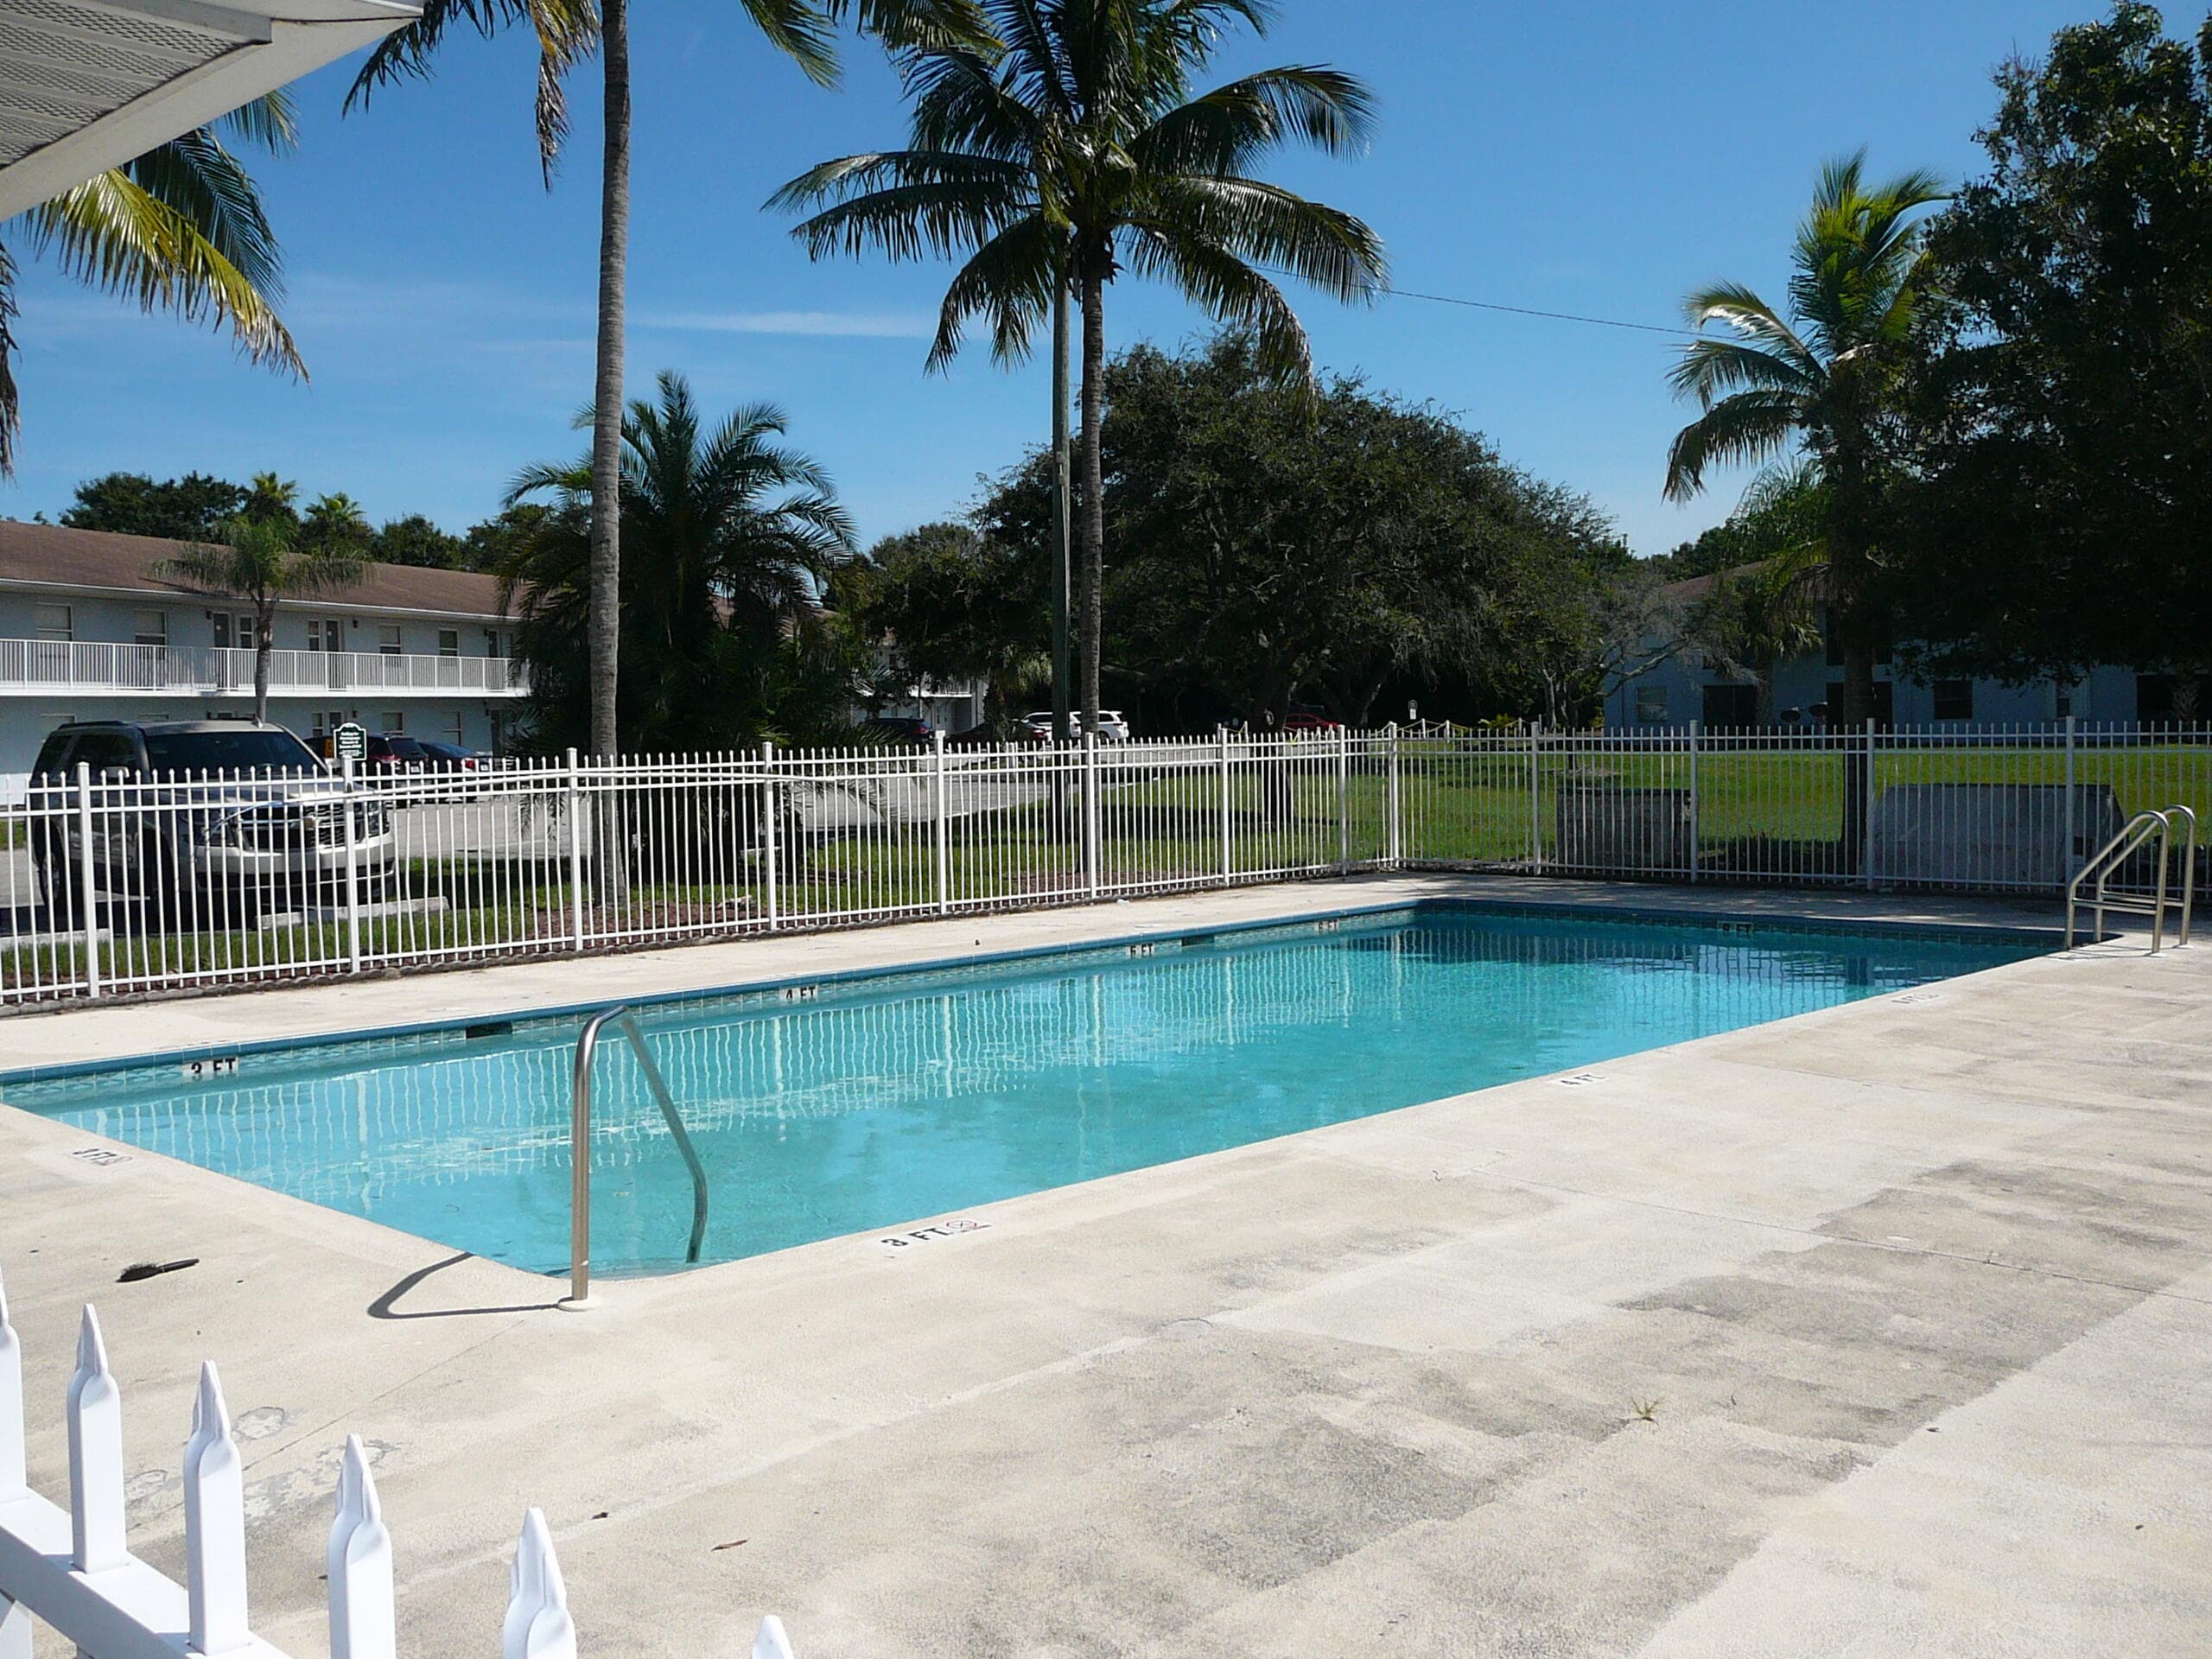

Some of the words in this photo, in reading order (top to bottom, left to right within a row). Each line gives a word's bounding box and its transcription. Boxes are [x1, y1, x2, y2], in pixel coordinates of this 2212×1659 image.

[1141, 943, 1154, 954] FT
[800, 986, 816, 997] FT
[191, 1062, 202, 1074] 3
[213, 1058, 236, 1071] FT
[880, 1238, 909, 1247] 3
[907, 1227, 950, 1241] FT
